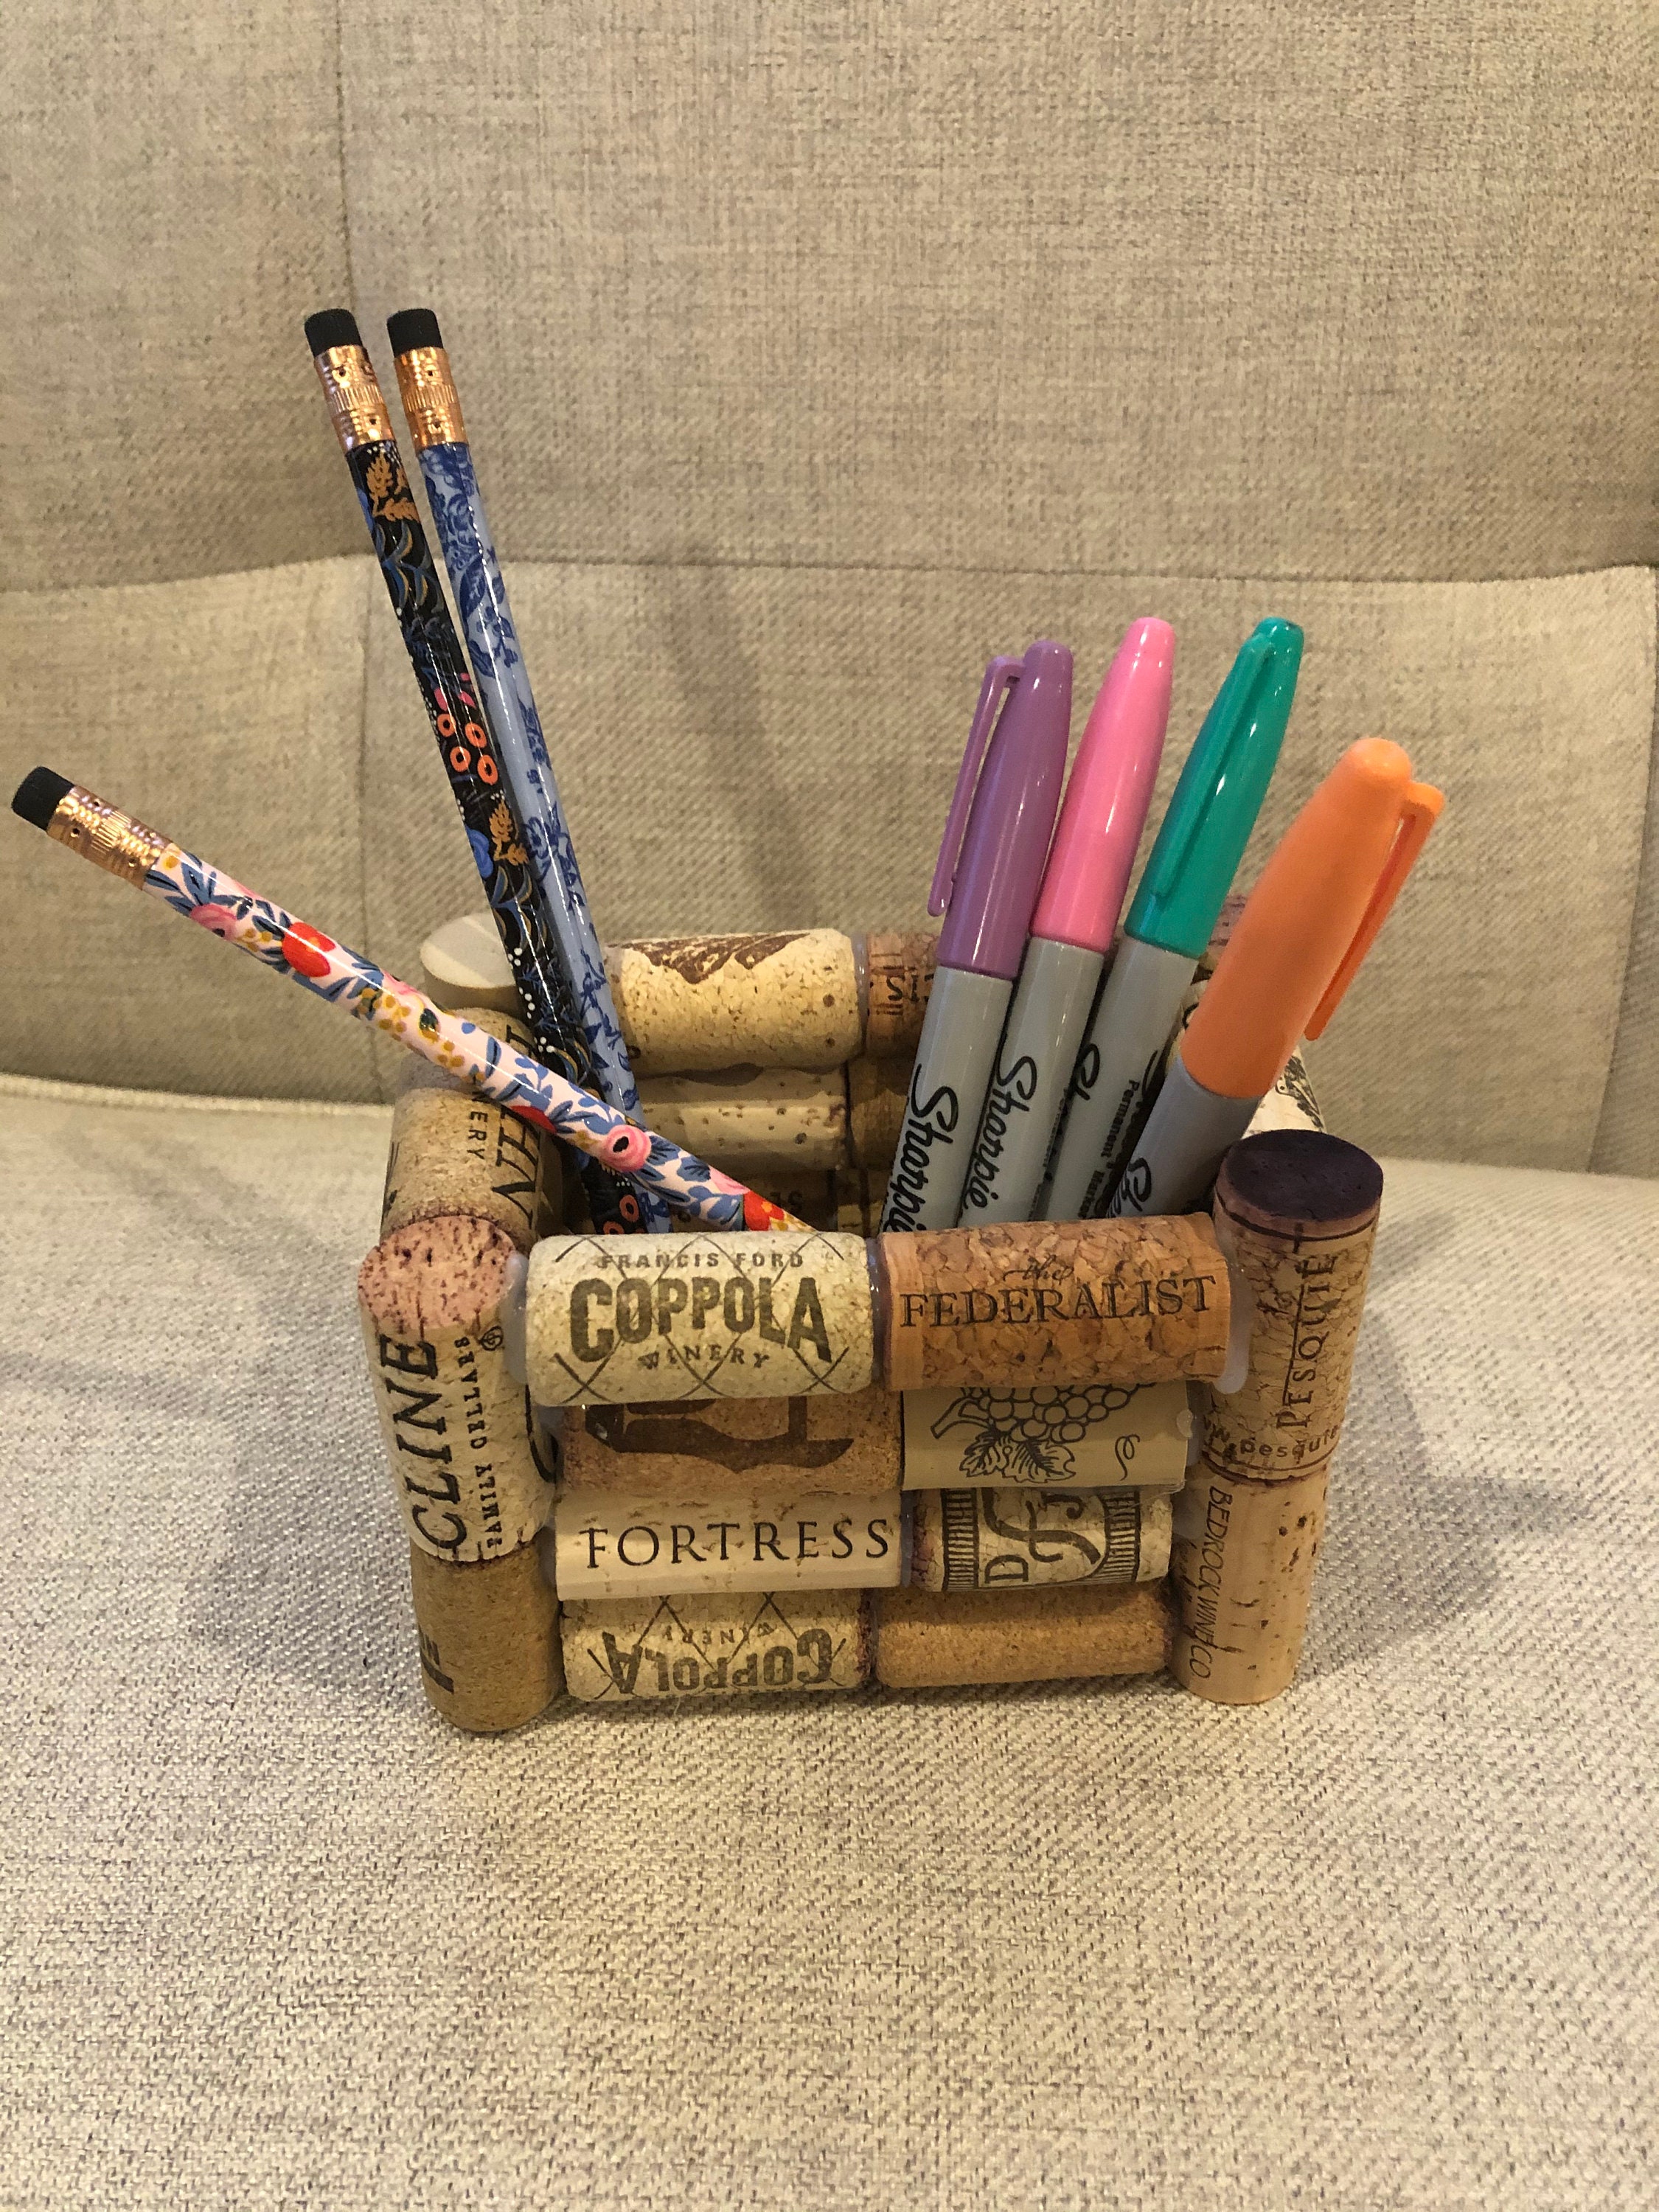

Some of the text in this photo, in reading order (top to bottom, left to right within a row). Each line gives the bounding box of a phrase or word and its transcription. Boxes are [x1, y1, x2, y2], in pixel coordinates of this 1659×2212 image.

[962, 1031, 1037, 1210] Sharpie
[599, 1251, 804, 1269] FRANCIS FORD
[1003, 1253, 1074, 1286] the
[569, 1276, 832, 1363] COPPOLA
[899, 1275, 1217, 1328] FEDERALIST
[638, 1343, 771, 1371] WINERY
[379, 1333, 467, 1550] CLINE
[453, 1336, 503, 1548] FAMILY CELLARS
[579, 1517, 891, 1569] FORTRESS
[1189, 1486, 1234, 1680] BEDROCK WINE CO
[602, 1628, 832, 1694] COPPOLA
